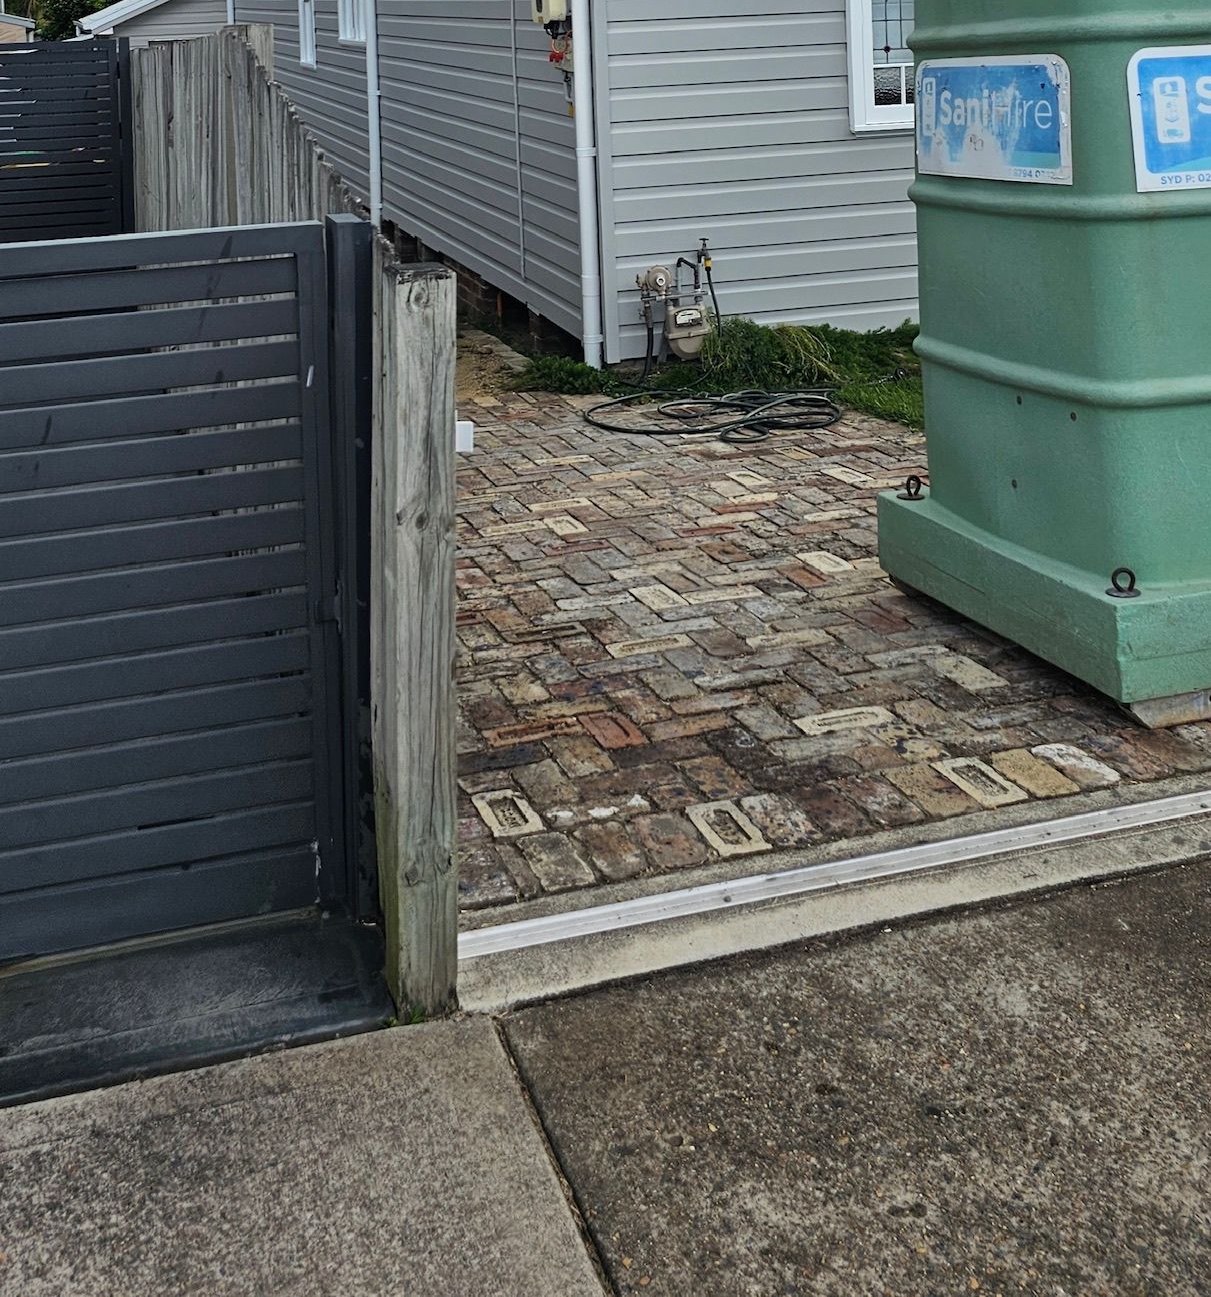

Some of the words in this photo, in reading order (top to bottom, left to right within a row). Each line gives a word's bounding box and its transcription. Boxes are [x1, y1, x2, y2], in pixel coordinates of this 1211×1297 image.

[940, 89, 1052, 129] SaniHire
[1160, 175, 1182, 185] SYD
[1185, 174, 1195, 183] P:
